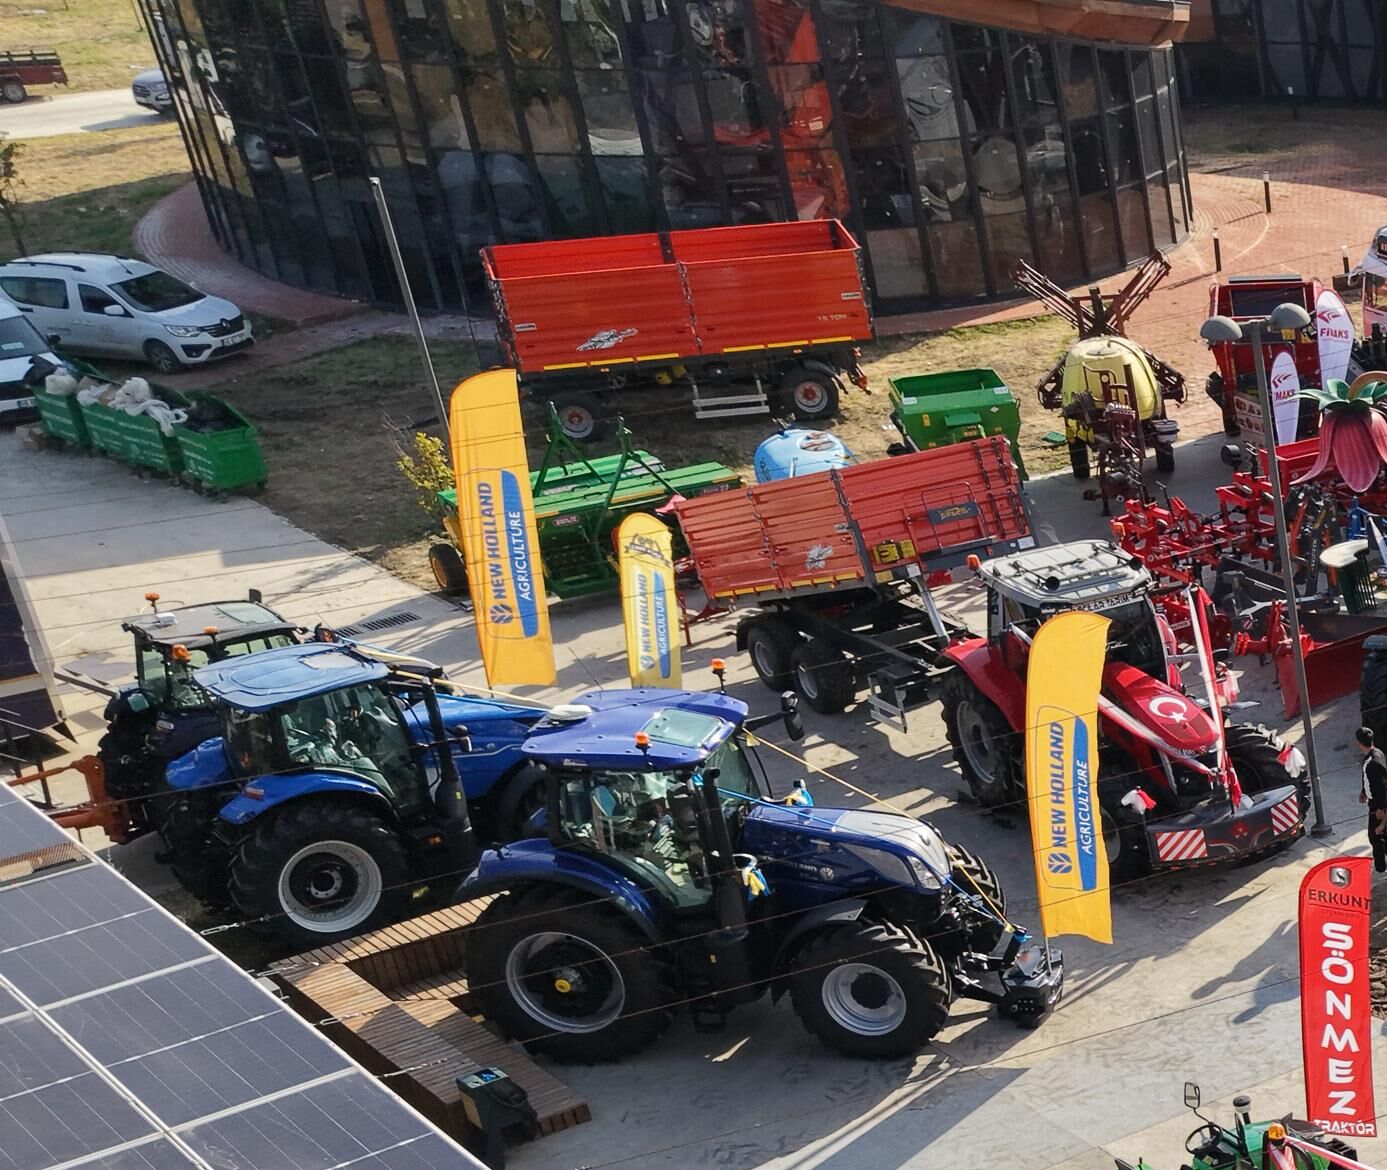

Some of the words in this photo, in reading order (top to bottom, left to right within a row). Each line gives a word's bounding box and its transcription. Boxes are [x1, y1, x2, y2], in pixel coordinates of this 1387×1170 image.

[477, 481, 501, 560] HOLLAND
[508, 510, 532, 601] AGRICULTURE
[489, 562, 507, 600] NEW
[654, 595, 669, 655] AGRICULTURE
[1049, 721, 1066, 807] HOLLAND
[1051, 808, 1068, 849] NEW
[1077, 759, 1092, 855] AGRICULTURE
[1309, 889, 1371, 911] ERKUNT
[1321, 921, 1360, 1116] SÖNMEZ
